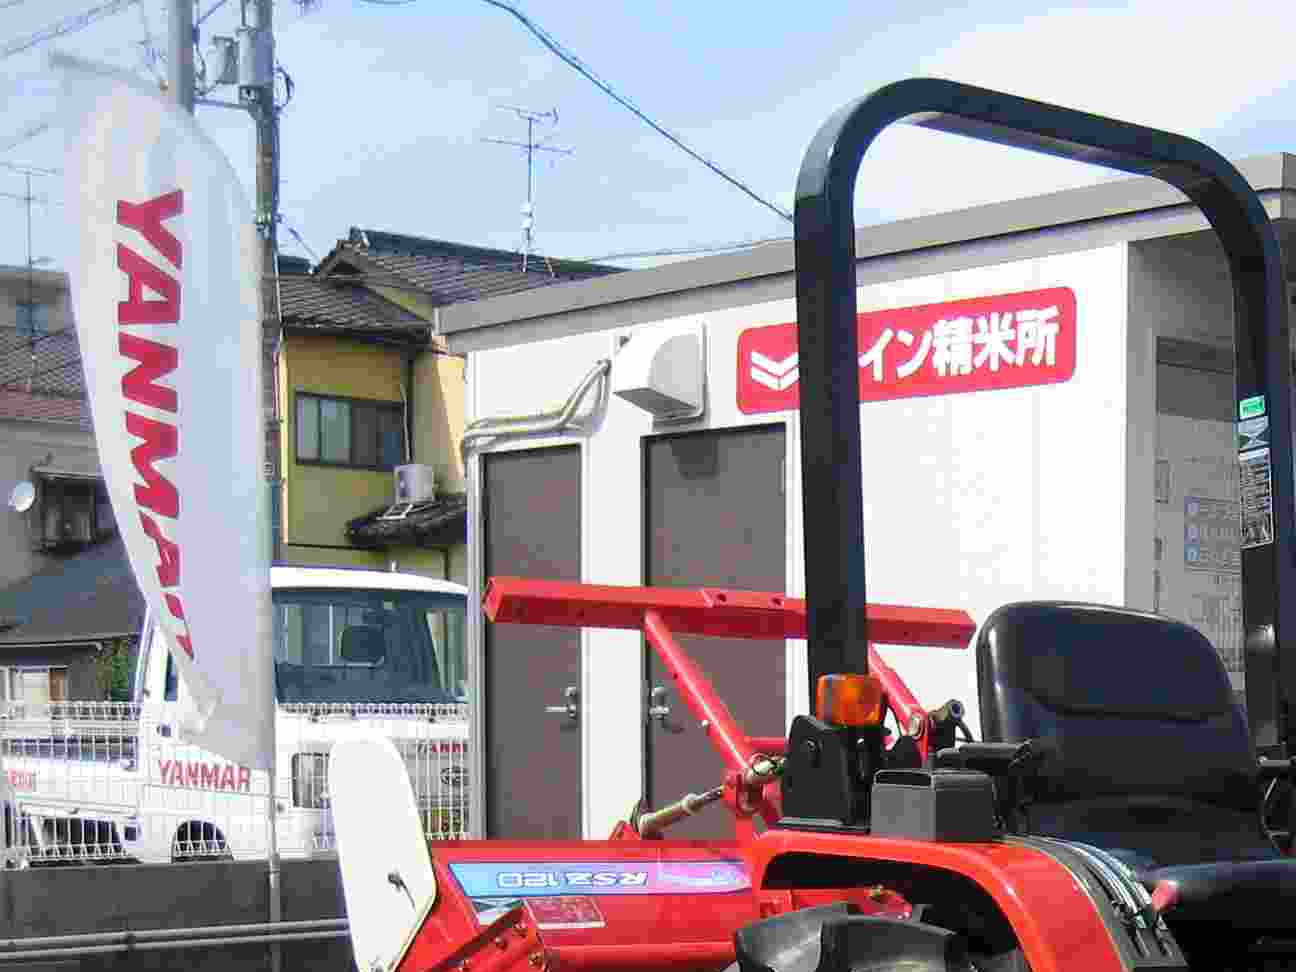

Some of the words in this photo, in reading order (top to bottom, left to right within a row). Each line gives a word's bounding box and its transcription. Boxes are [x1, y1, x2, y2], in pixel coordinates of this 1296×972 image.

[858, 305, 1059, 383] イン精米所
[158, 758, 250, 793] YANMAR
